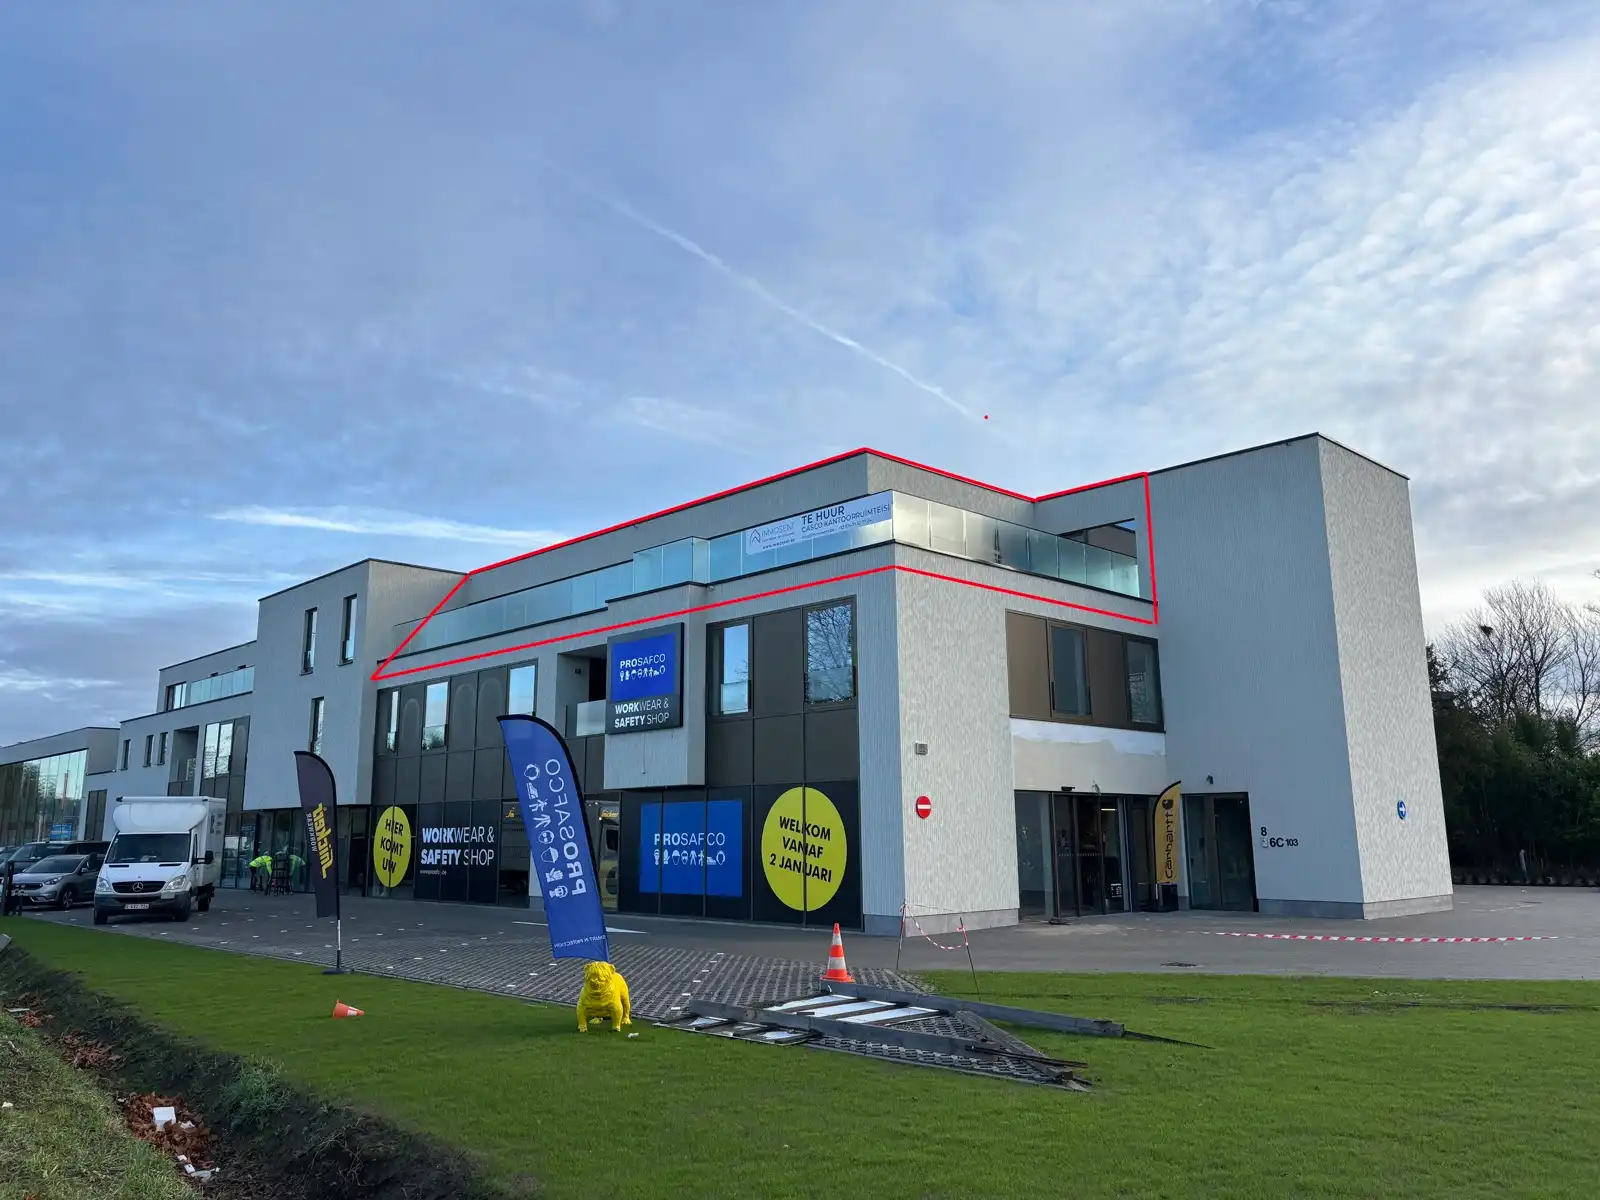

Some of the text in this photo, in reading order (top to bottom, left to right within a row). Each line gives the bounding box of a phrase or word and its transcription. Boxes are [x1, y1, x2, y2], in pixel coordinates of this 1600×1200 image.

[801, 505, 845, 526] TE HUUR
[801, 520, 823, 533] CASCO
[620, 653, 666, 669] PROSAFCO
[615, 697, 669, 714] WORKWEAR &
[614, 712, 670, 728] SAFETY SHOP
[422, 826, 495, 844] WORKWEAR &
[779, 815, 831, 841] WELKOM
[1261, 826, 1267, 837] 8
[380, 836, 404, 857] KOMT
[654, 832, 726, 846] PROSAFCO
[782, 836, 824, 859] VANAF
[1270, 837, 1299, 848] 6C 103
[382, 857, 397, 874] UW
[421, 848, 495, 866] SAFETY SHOP
[770, 854, 832, 883] 2 JANUARI
